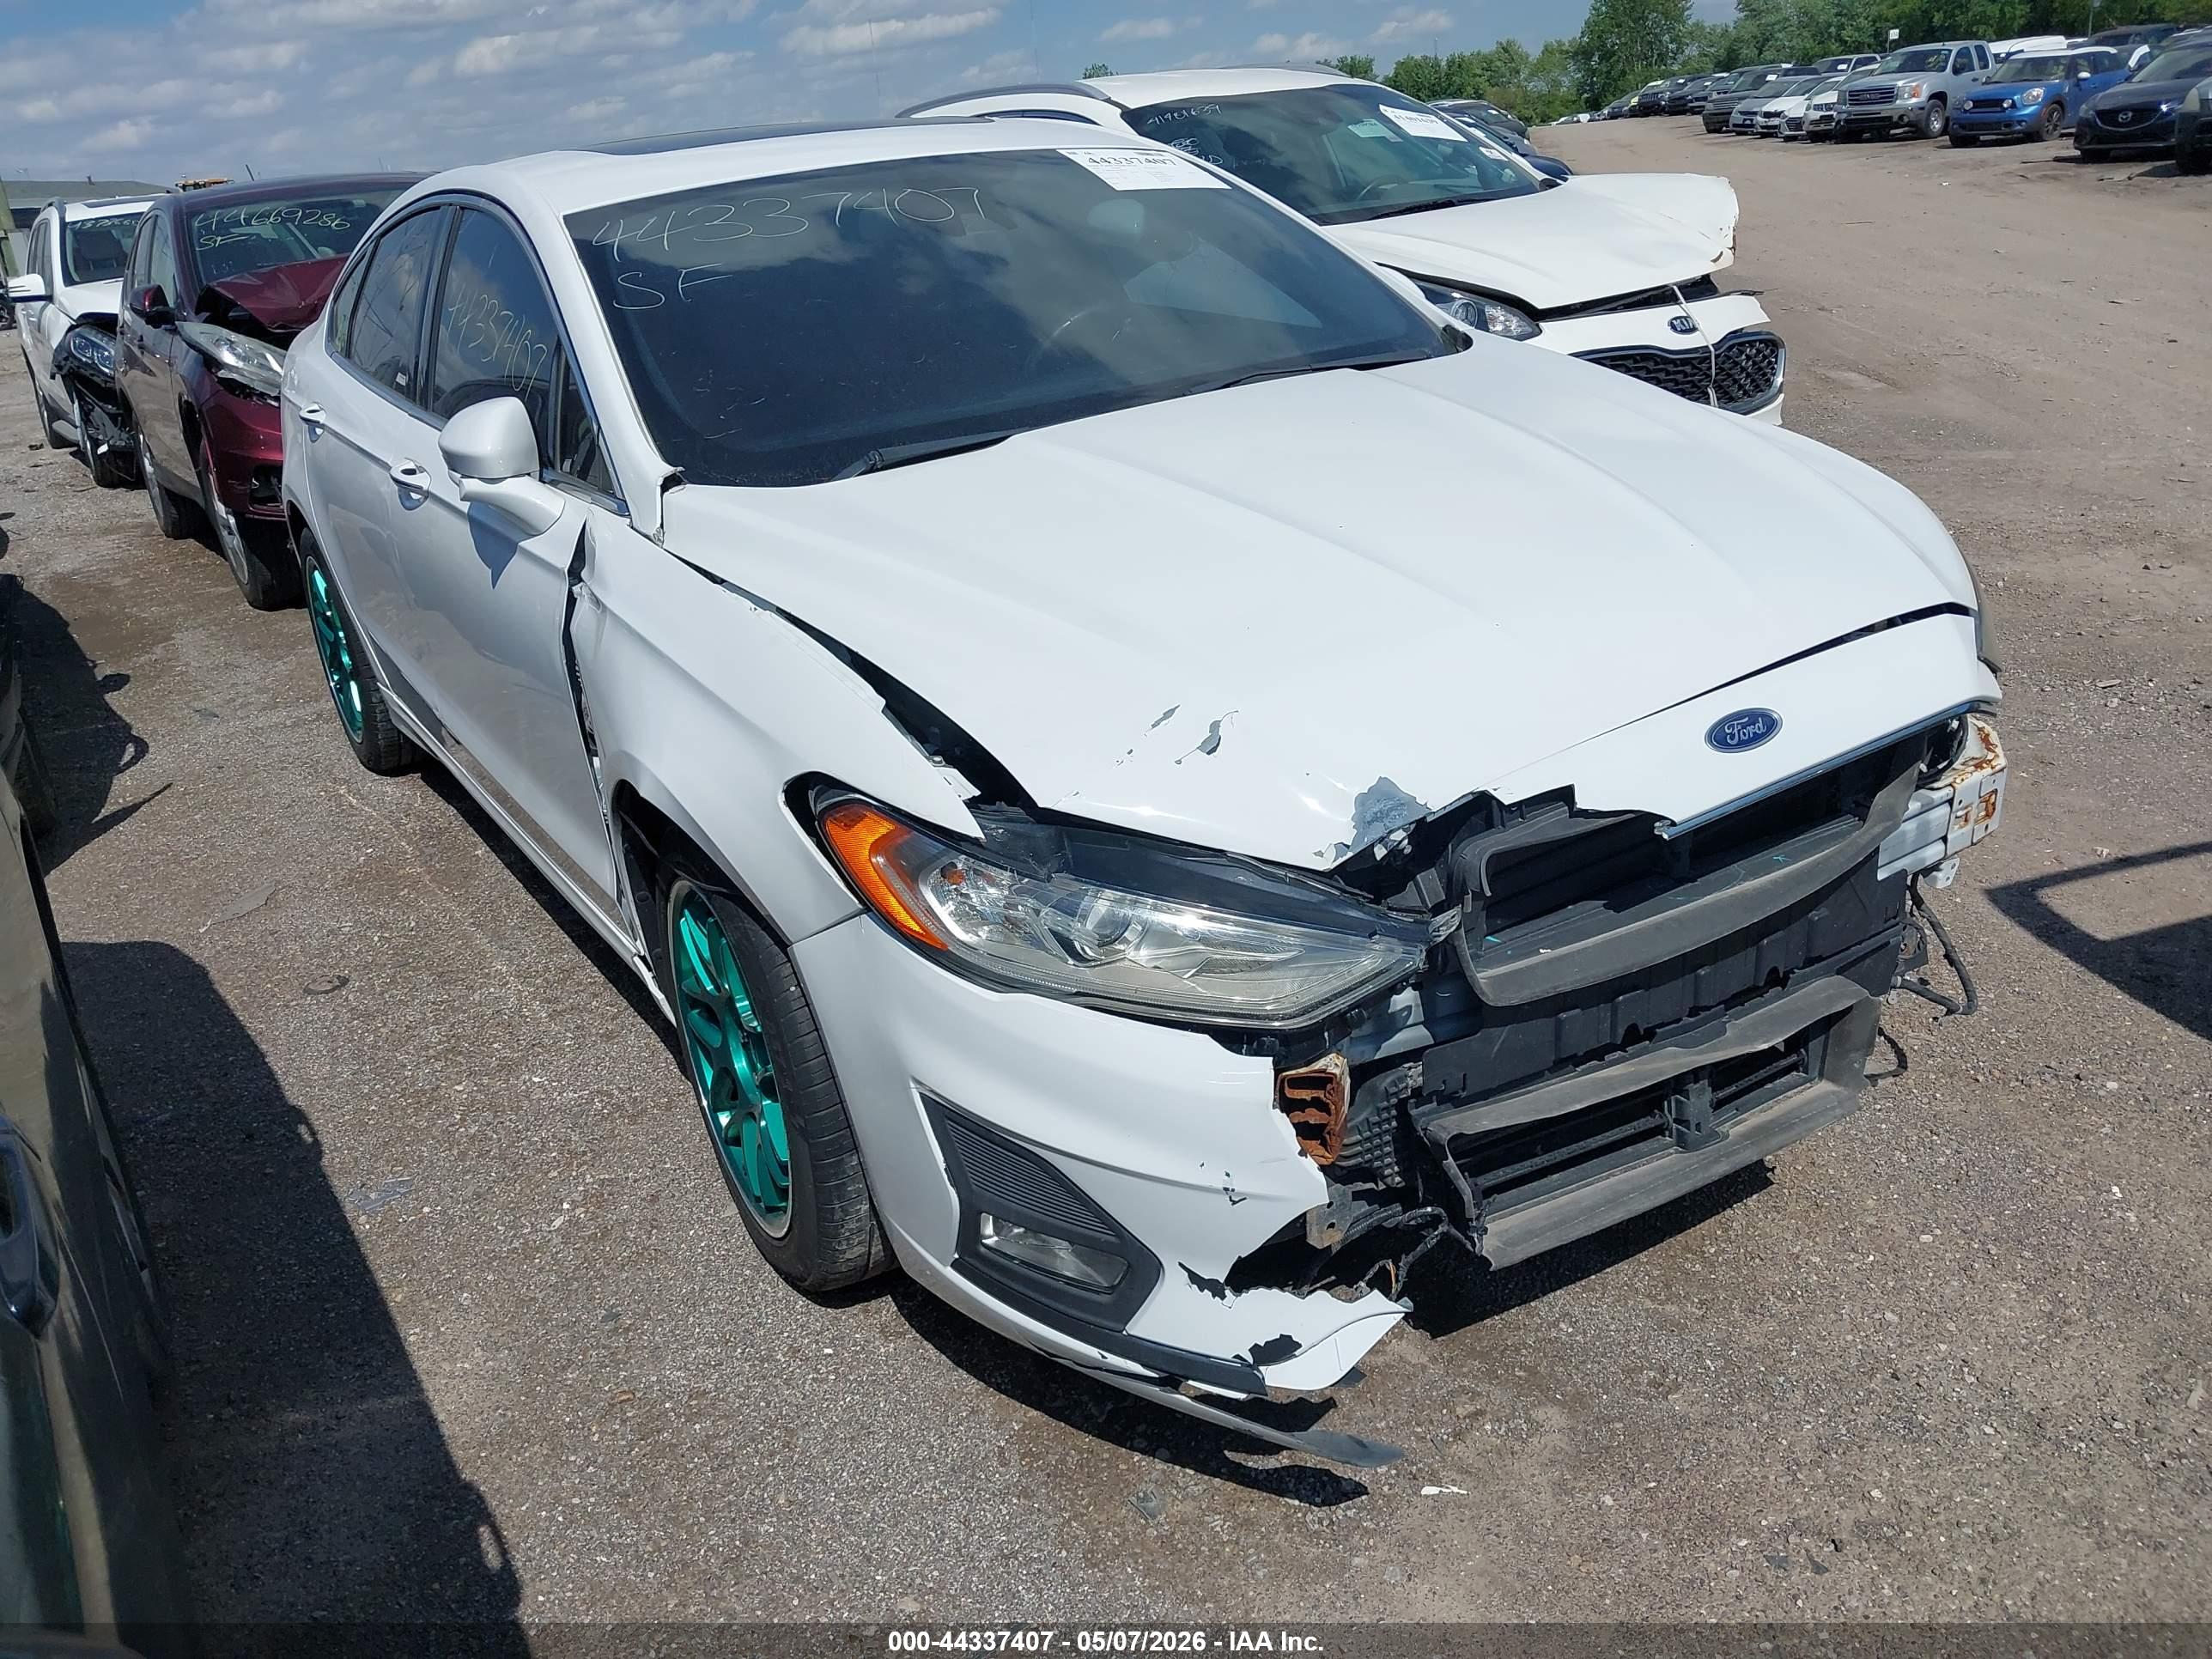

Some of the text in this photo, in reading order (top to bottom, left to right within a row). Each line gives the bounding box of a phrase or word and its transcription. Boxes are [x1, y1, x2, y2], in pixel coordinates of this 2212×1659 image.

[195, 207, 350, 230] 44669286
[592, 187, 986, 261] 44337407
[613, 264, 734, 309] SF
[1724, 716, 1767, 745] Ford
